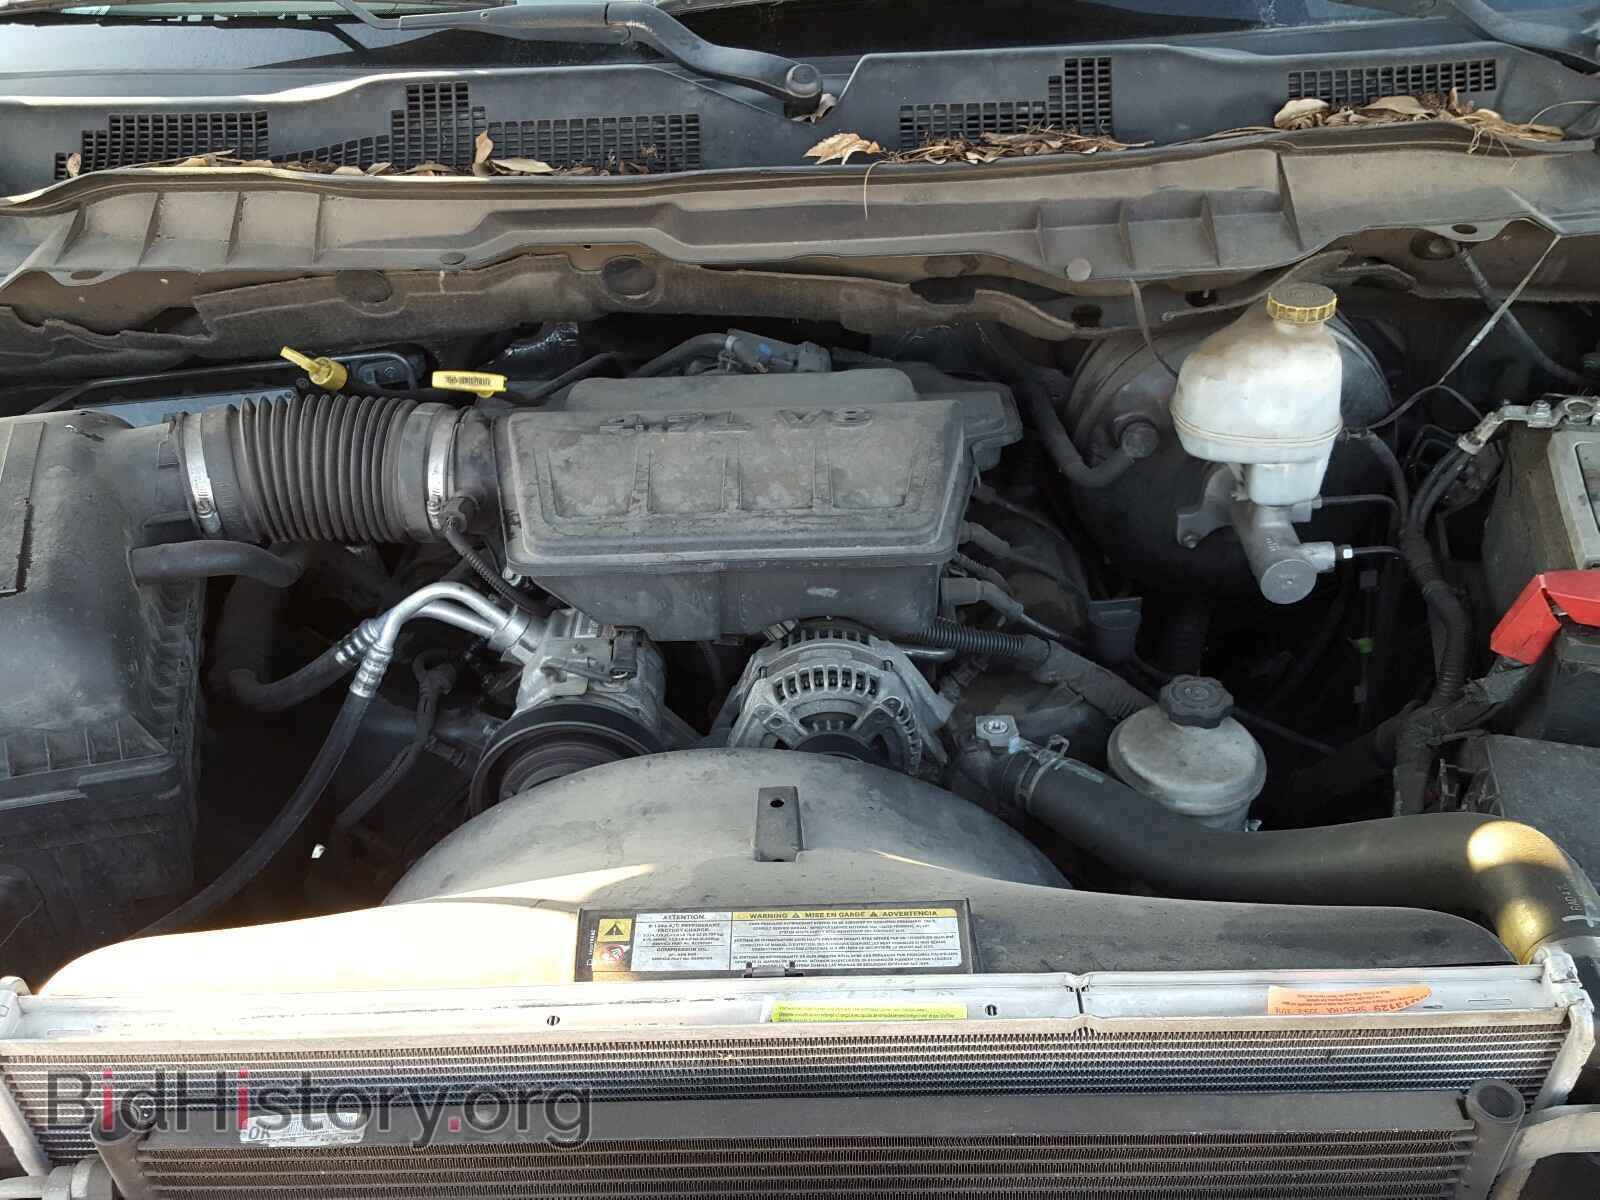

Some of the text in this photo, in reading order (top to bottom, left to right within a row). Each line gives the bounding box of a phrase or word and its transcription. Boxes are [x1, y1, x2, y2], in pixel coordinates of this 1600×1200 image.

[882, 910, 937, 918] ADVERTENCIA
[1326, 1005, 1368, 1015] SPECTRA
[248, 1125, 272, 1140] OK
